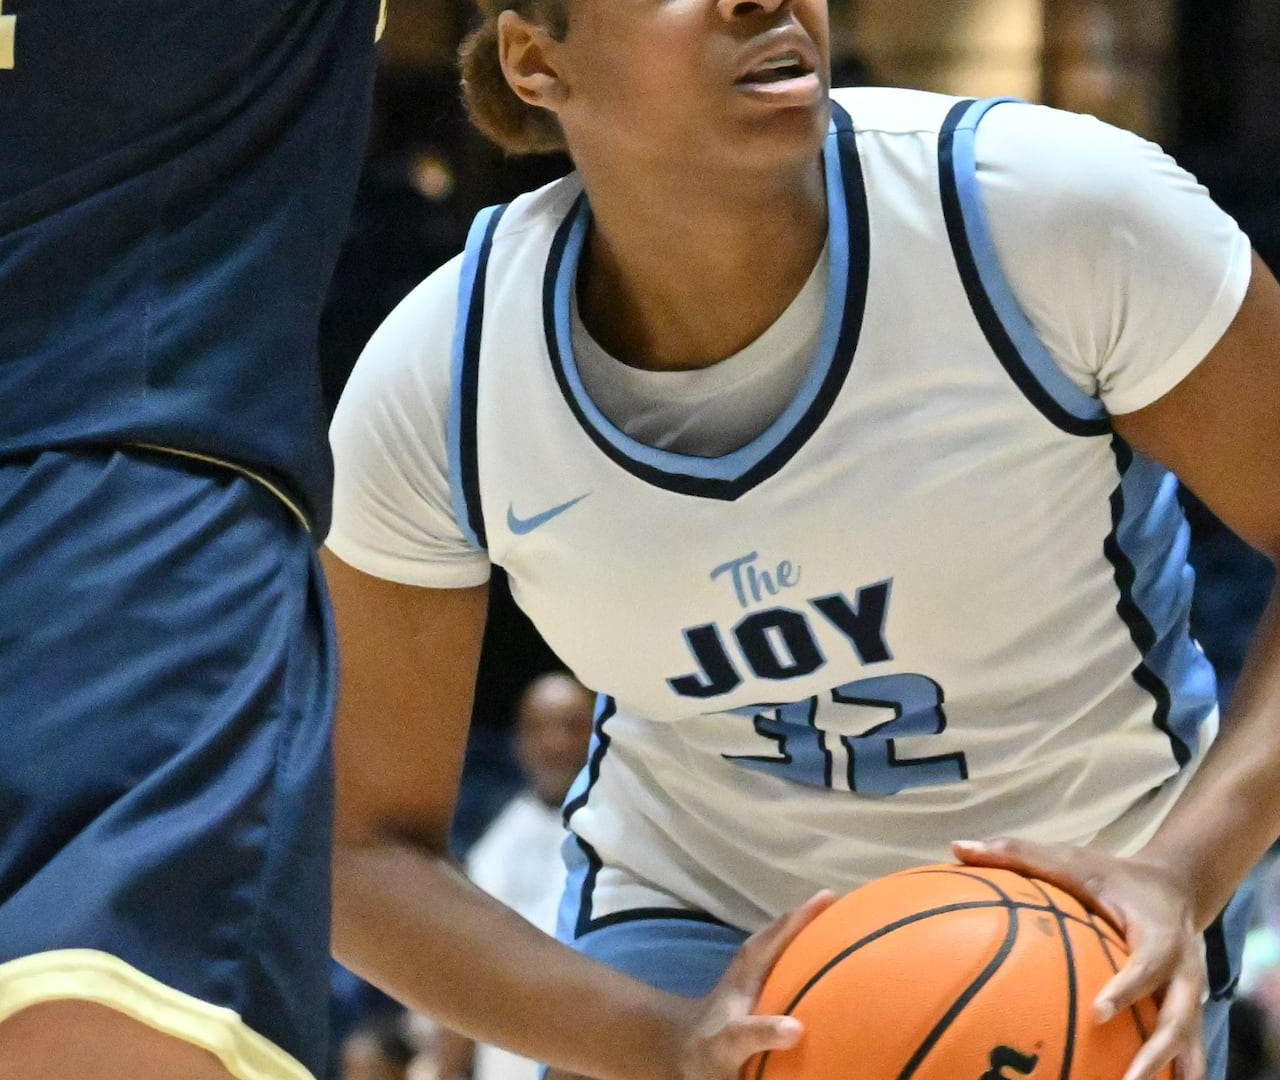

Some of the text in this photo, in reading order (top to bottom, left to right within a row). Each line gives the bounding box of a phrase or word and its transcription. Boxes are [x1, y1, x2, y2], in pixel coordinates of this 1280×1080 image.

[666, 577, 894, 699] JOY
[710, 551, 801, 608] The
[702, 672, 968, 796] 32
